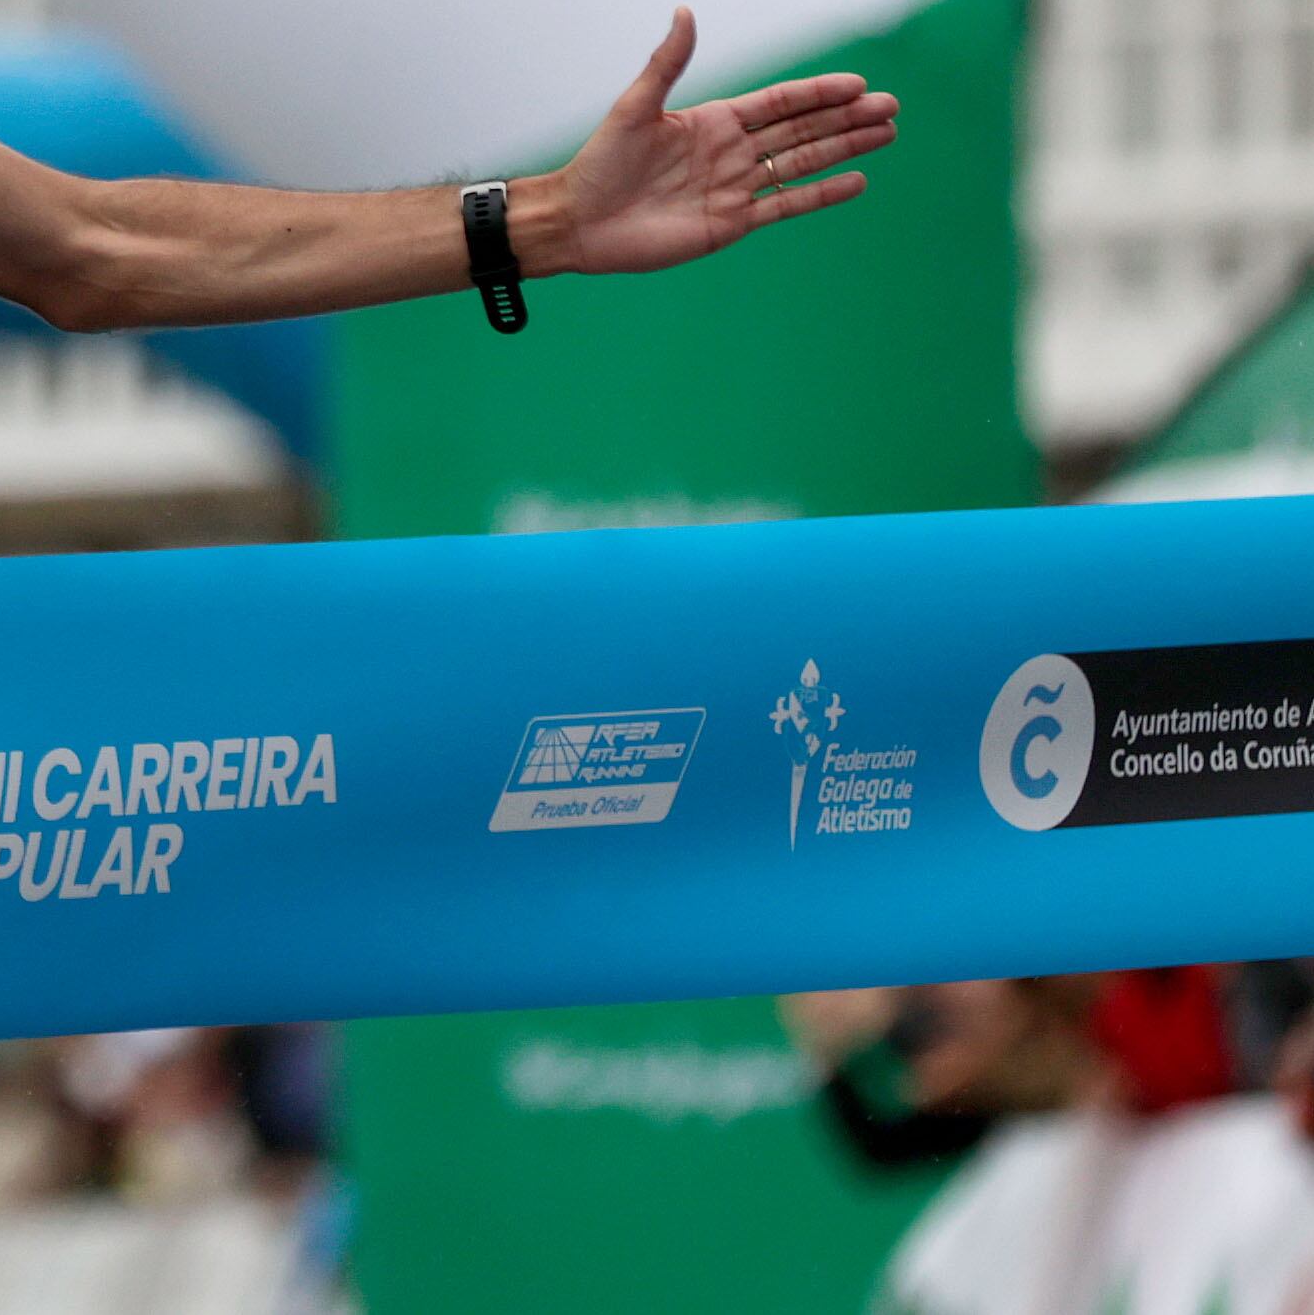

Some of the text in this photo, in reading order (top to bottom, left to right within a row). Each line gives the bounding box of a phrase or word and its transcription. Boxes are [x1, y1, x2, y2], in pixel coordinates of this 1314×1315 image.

[1111, 702, 1269, 746] Ayuntamiento
[1273, 697, 1301, 729] de
[822, 743, 918, 773] Federación
[1110, 742, 1205, 778] Concello
[1210, 740, 1238, 773] da
[31, 733, 337, 822] CARREIRA
[818, 773, 914, 809] Galega de
[531, 794, 645, 819] Prueba Oficial
[816, 803, 912, 835] Atletismo
